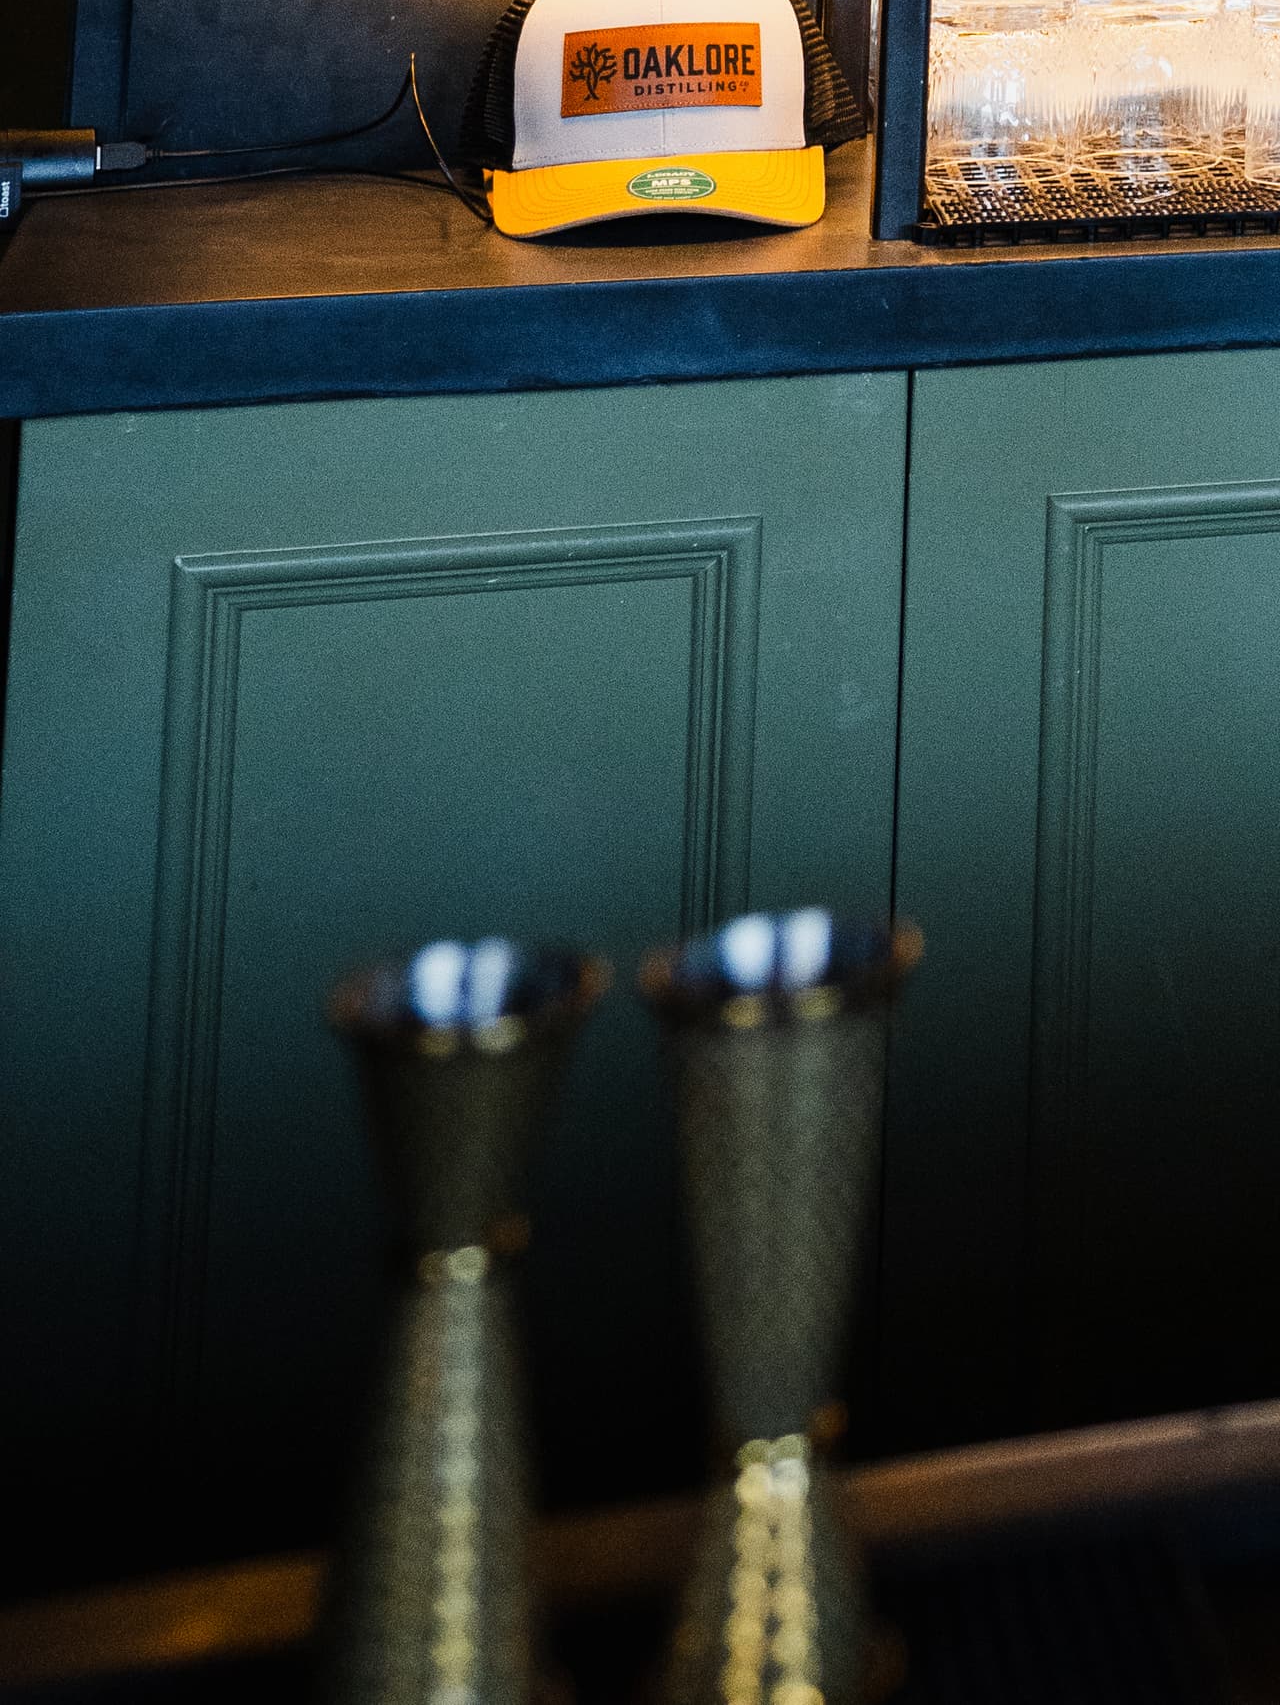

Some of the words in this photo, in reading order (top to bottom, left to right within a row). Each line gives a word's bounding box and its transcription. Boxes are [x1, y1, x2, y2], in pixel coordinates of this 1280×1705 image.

[623, 44, 755, 80] OAKLORE
[634, 82, 737, 97] DISTILLING
[652, 179, 691, 187] MPS
[1, 181, 10, 207] toast
